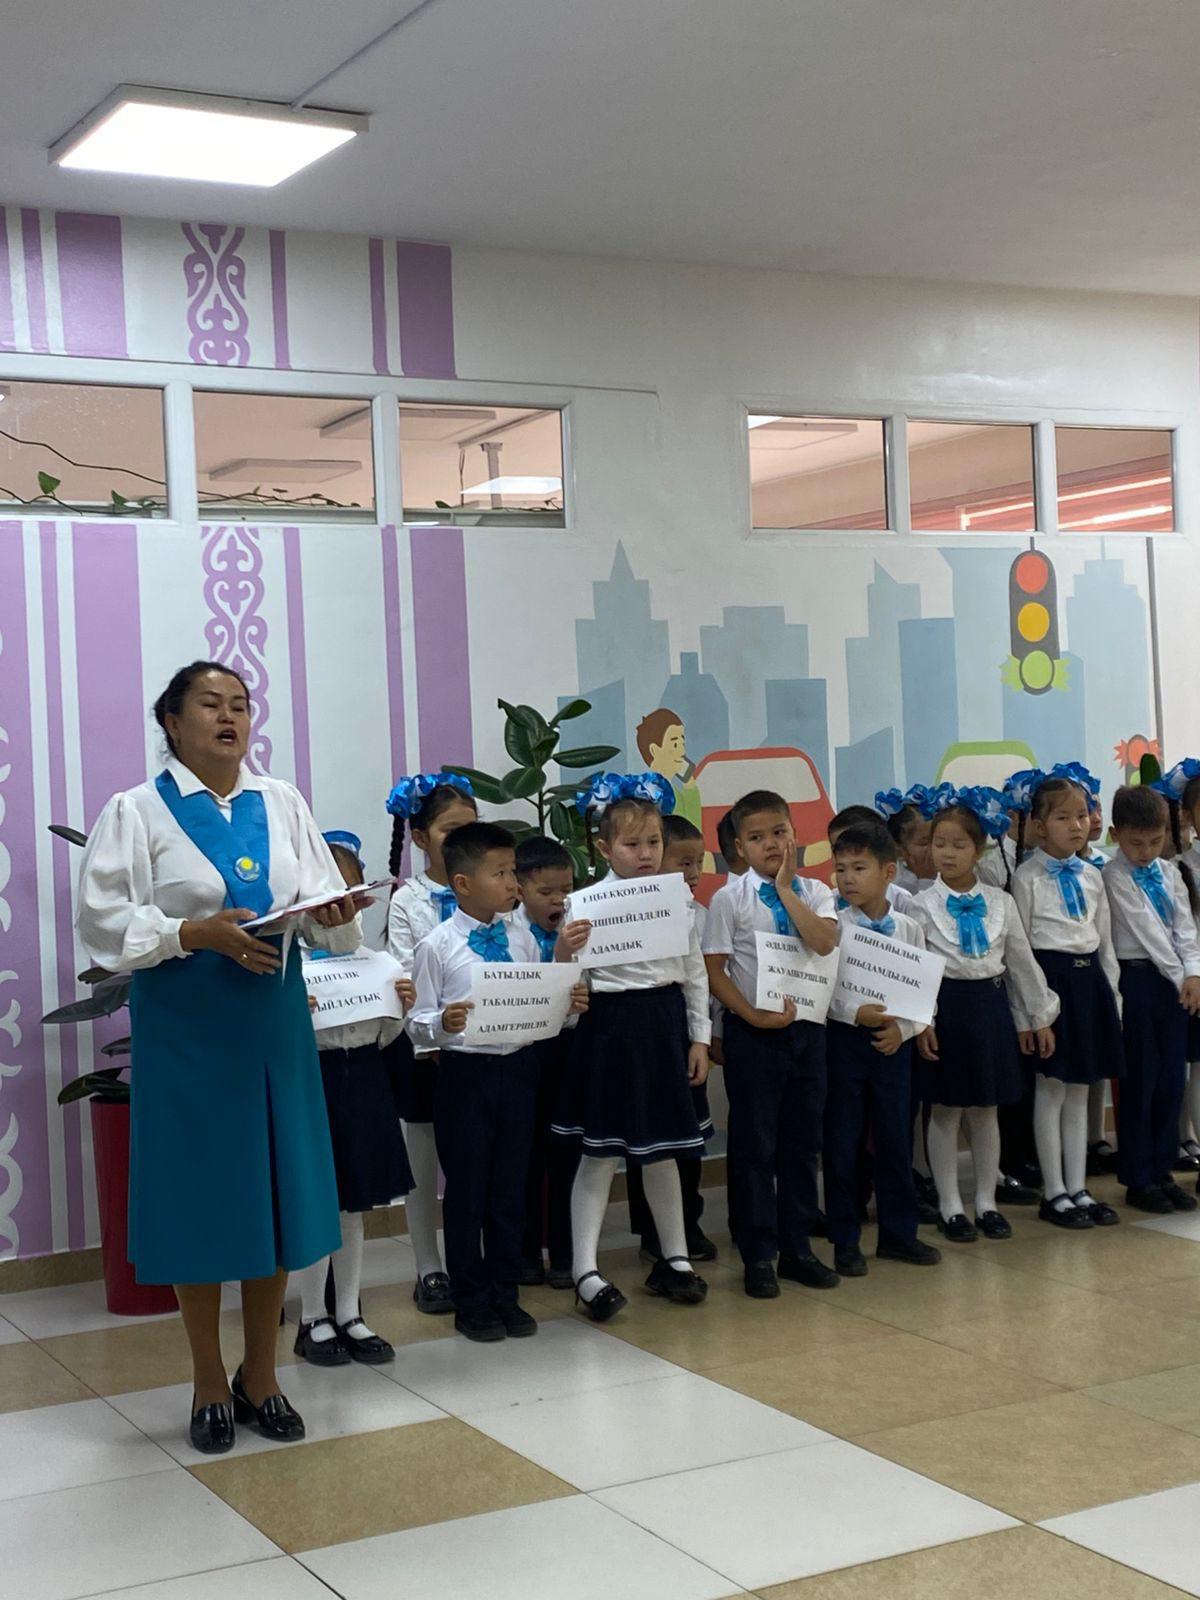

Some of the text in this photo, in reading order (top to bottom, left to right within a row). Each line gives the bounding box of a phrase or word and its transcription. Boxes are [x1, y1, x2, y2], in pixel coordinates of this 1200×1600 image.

[582, 883, 661, 904] ЕҢБЕКҚОРЛЫҚ
[590, 940, 643, 956] АДАМДЫҚ
[853, 932, 922, 964] ШЫНАЙЫЛЫҚ
[483, 970, 543, 981] БАТЫЛДЫҚ
[846, 955, 922, 990] ШЫДАМДЫЛЫҚ
[316, 991, 383, 1013] ЫЙЛАСТЫҚ
[481, 996, 552, 1007] ТАБАНДЫЛЫҚ
[840, 980, 887, 1003] АДАЛДЫҚ
